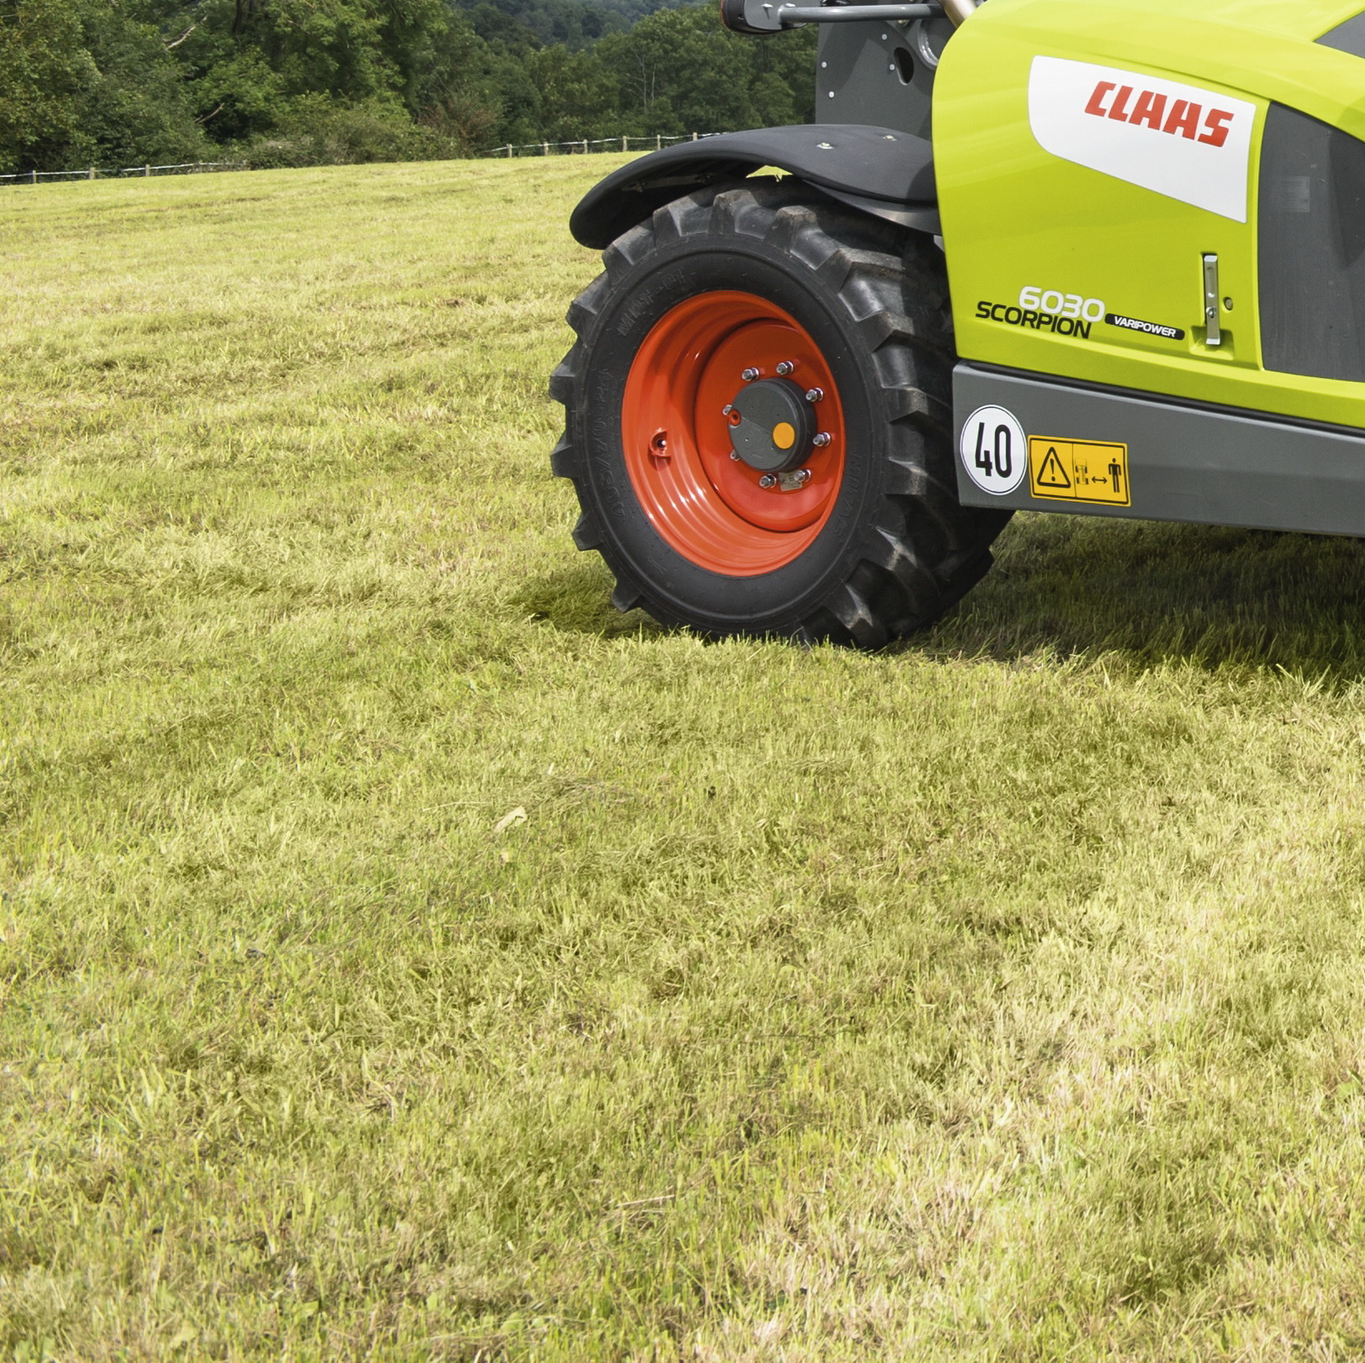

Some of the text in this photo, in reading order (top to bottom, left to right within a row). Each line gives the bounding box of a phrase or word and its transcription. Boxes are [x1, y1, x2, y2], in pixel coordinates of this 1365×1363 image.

[1084, 80, 1234, 148] CLAAS
[975, 300, 1092, 339] SCORPION
[1018, 285, 1106, 322] 6030
[1114, 315, 1177, 338] VARIPOWER
[975, 422, 1012, 478] 40
